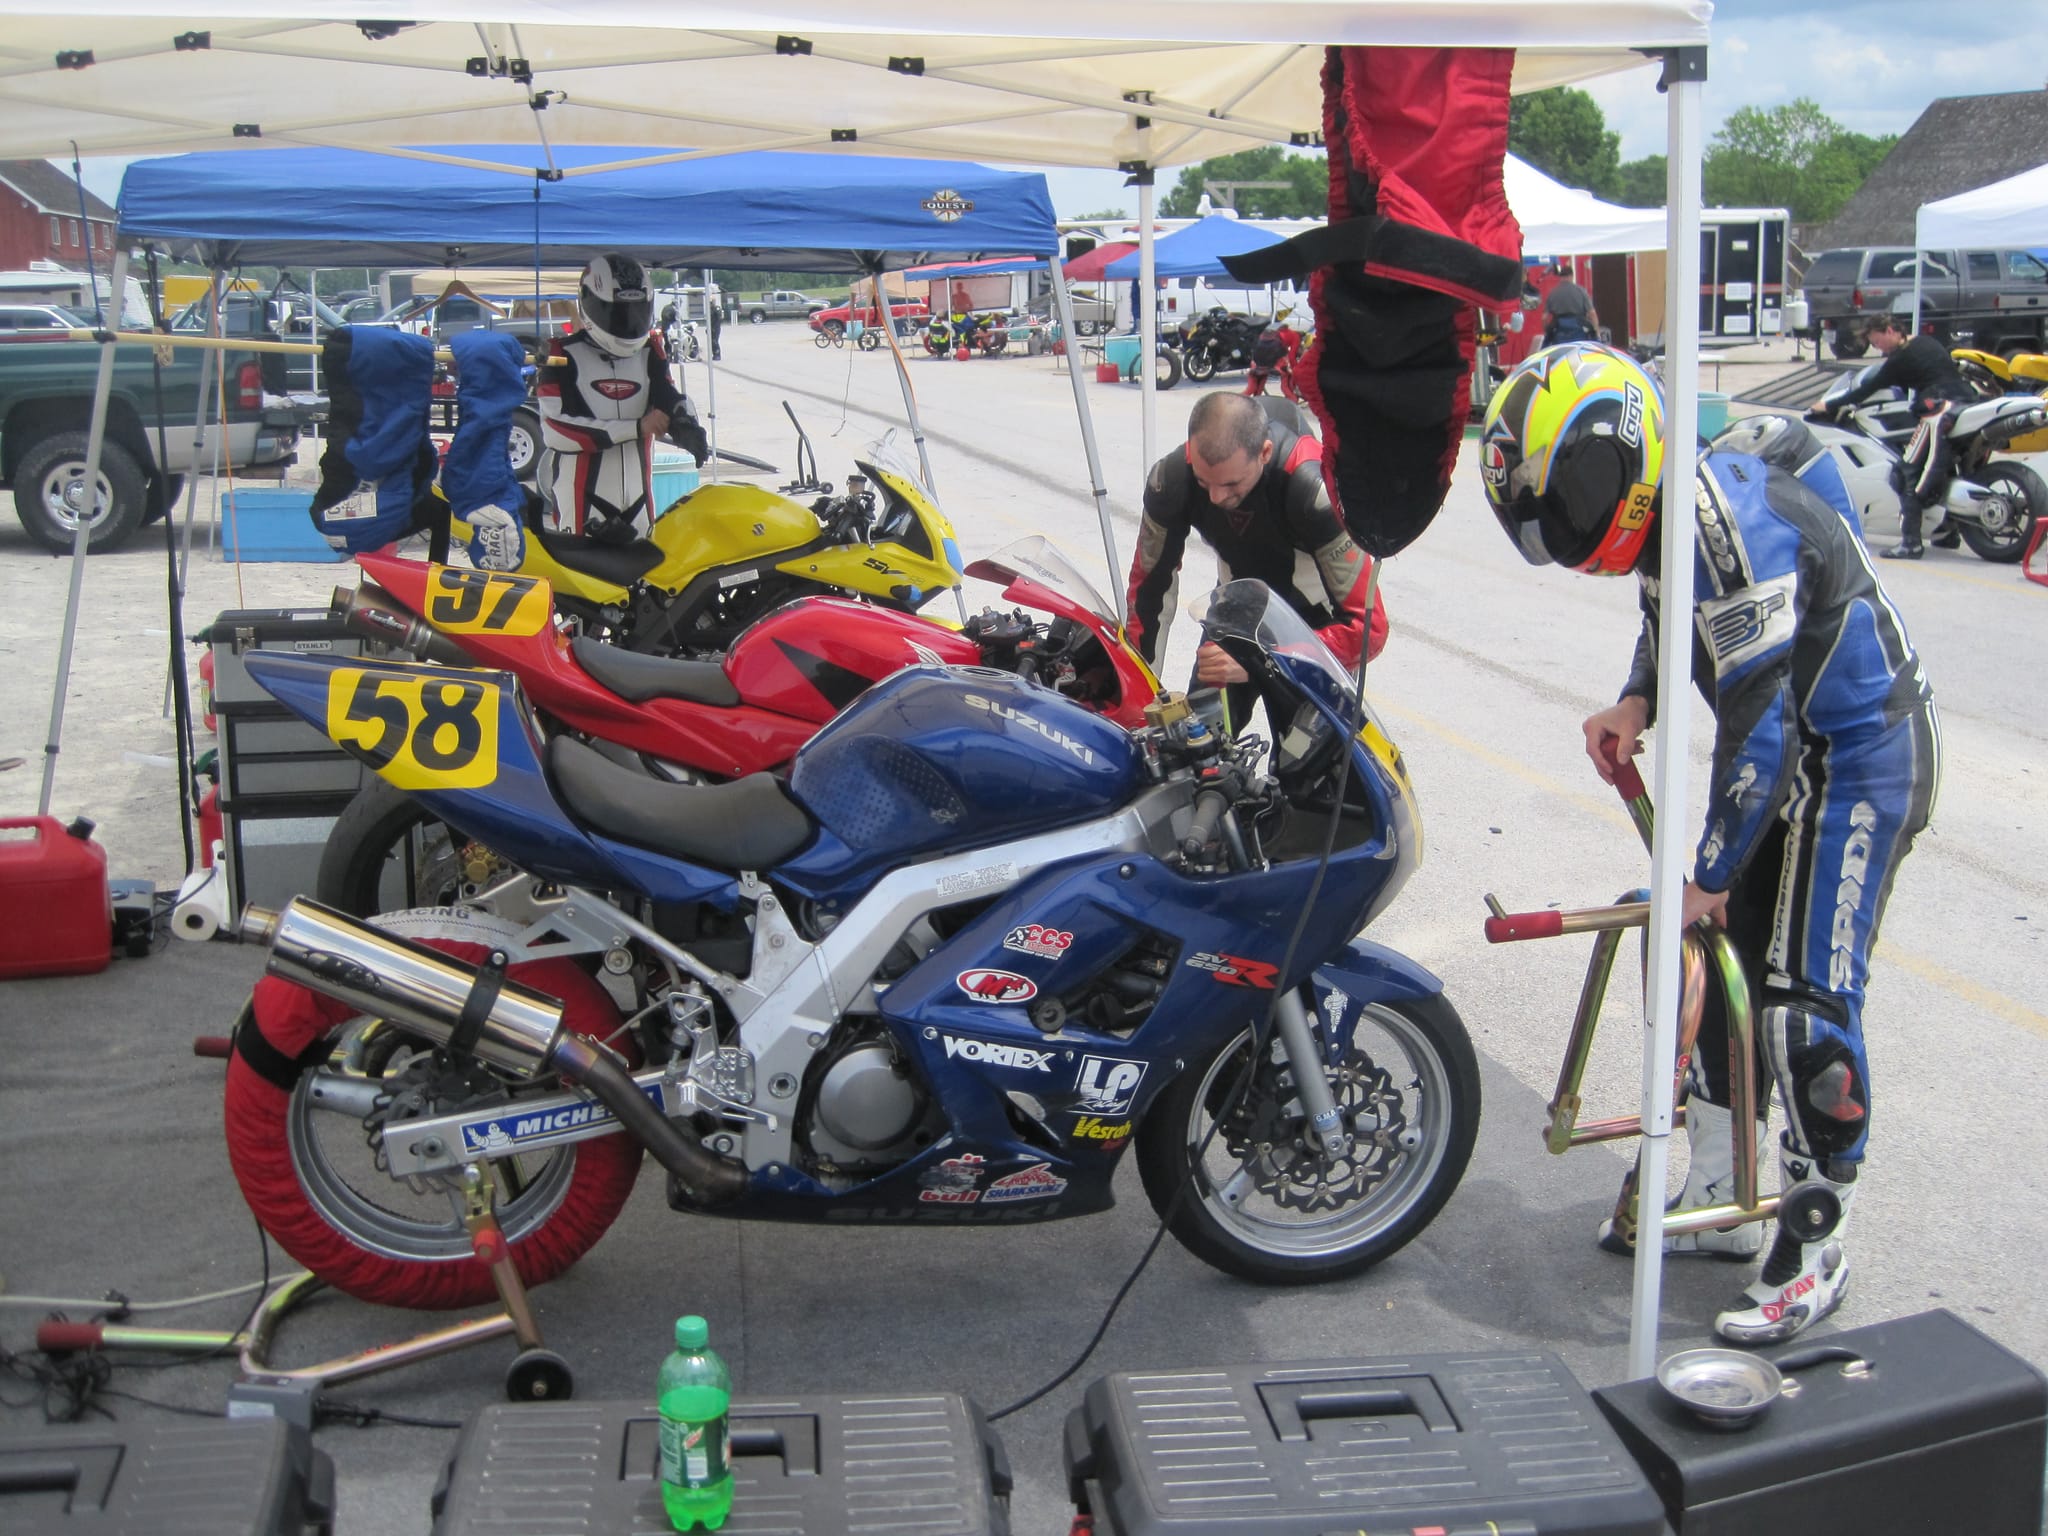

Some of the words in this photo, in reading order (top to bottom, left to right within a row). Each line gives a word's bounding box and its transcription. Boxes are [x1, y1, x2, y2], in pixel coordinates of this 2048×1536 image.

[1624, 390, 1641, 438] agv
[1628, 494, 1651, 522] 58
[431, 568, 540, 630] 97
[296, 642, 330, 650] STANLEY
[338, 670, 486, 772] 58
[963, 693, 1094, 766] SUZUKI
[1026, 924, 1074, 950] CCS
[1185, 958, 1238, 976] 650
[1191, 951, 1229, 964] SV
[942, 1035, 1057, 1073] VORTEX
[1079, 1059, 1141, 1101] LP
[1072, 1115, 1133, 1140] Vesrah
[919, 1189, 981, 1204] bull
[823, 1201, 1062, 1223] SUZUKI
